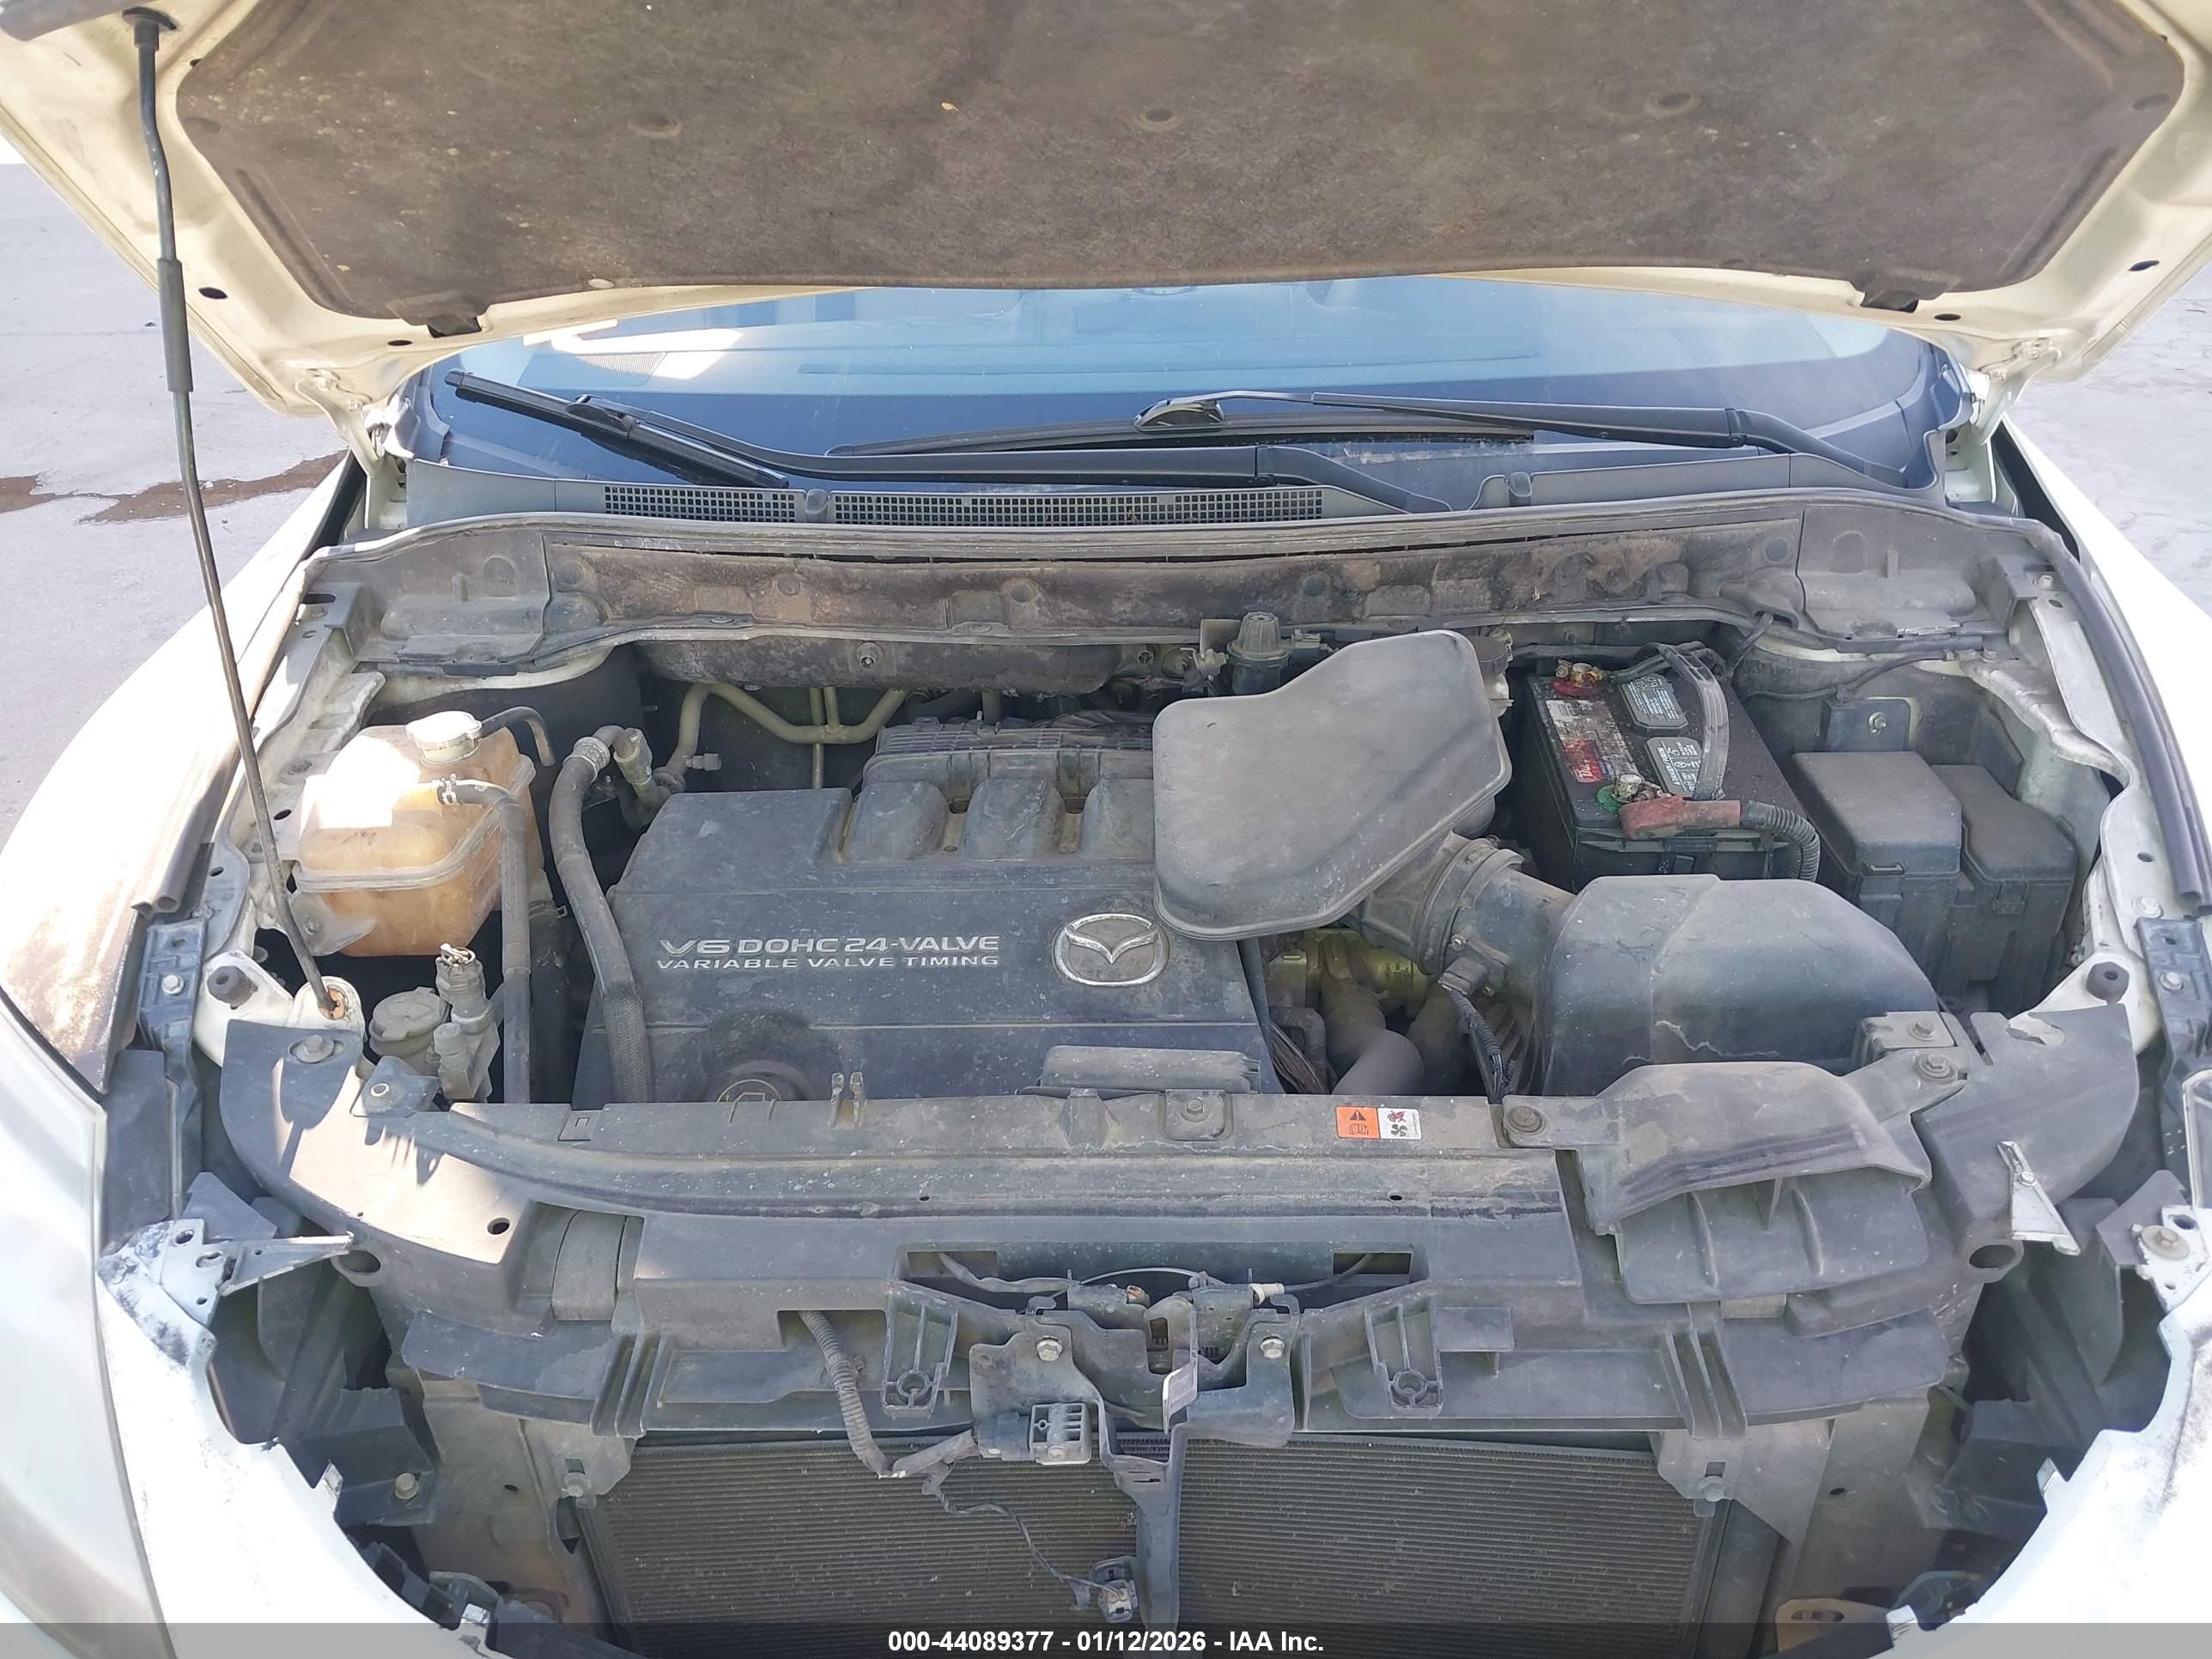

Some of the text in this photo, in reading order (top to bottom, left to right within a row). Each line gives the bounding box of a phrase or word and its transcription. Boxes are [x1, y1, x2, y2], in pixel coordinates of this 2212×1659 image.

[659, 936, 1000, 955] V6 DOHC 24-VALVE
[656, 956, 1000, 969] VARIABLE VALVE TIMING
